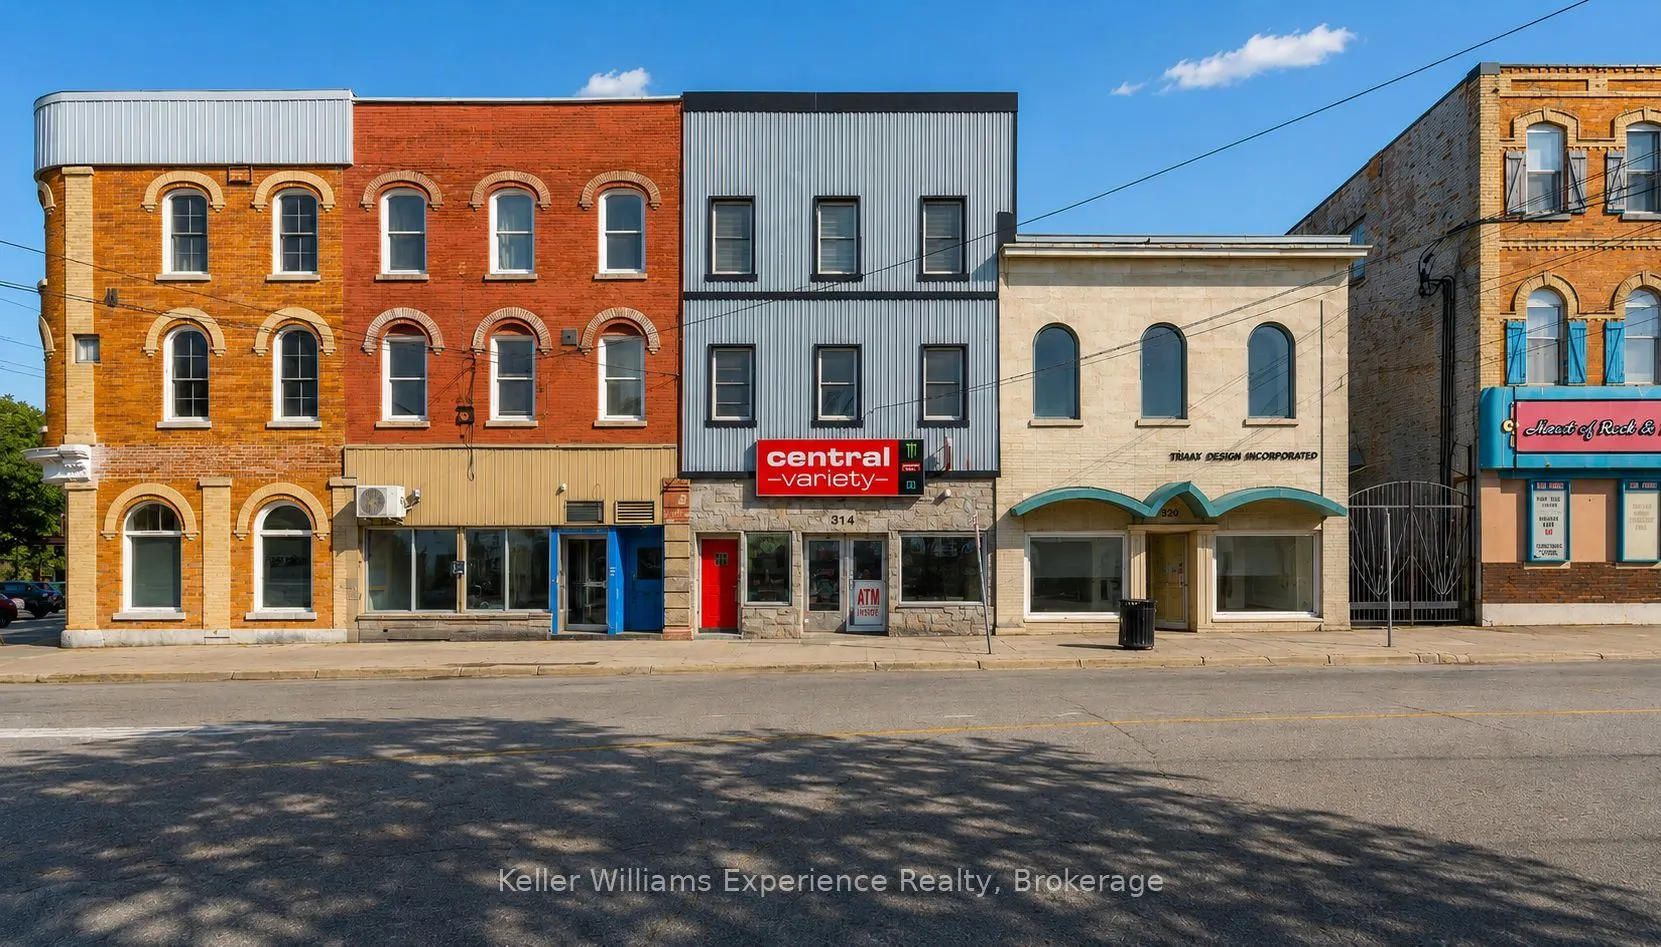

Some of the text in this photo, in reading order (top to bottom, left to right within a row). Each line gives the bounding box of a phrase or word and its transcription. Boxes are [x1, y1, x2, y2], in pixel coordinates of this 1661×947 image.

[1578, 420, 1597, 441] of
[1597, 419, 1637, 436] Rock
[1639, 419, 1655, 435] &
[767, 446, 890, 467] central
[1205, 451, 1242, 462] DESIGN
[1243, 451, 1318, 462] INCORPORATED
[831, 515, 854, 525] 314
[857, 588, 880, 605] ATM
